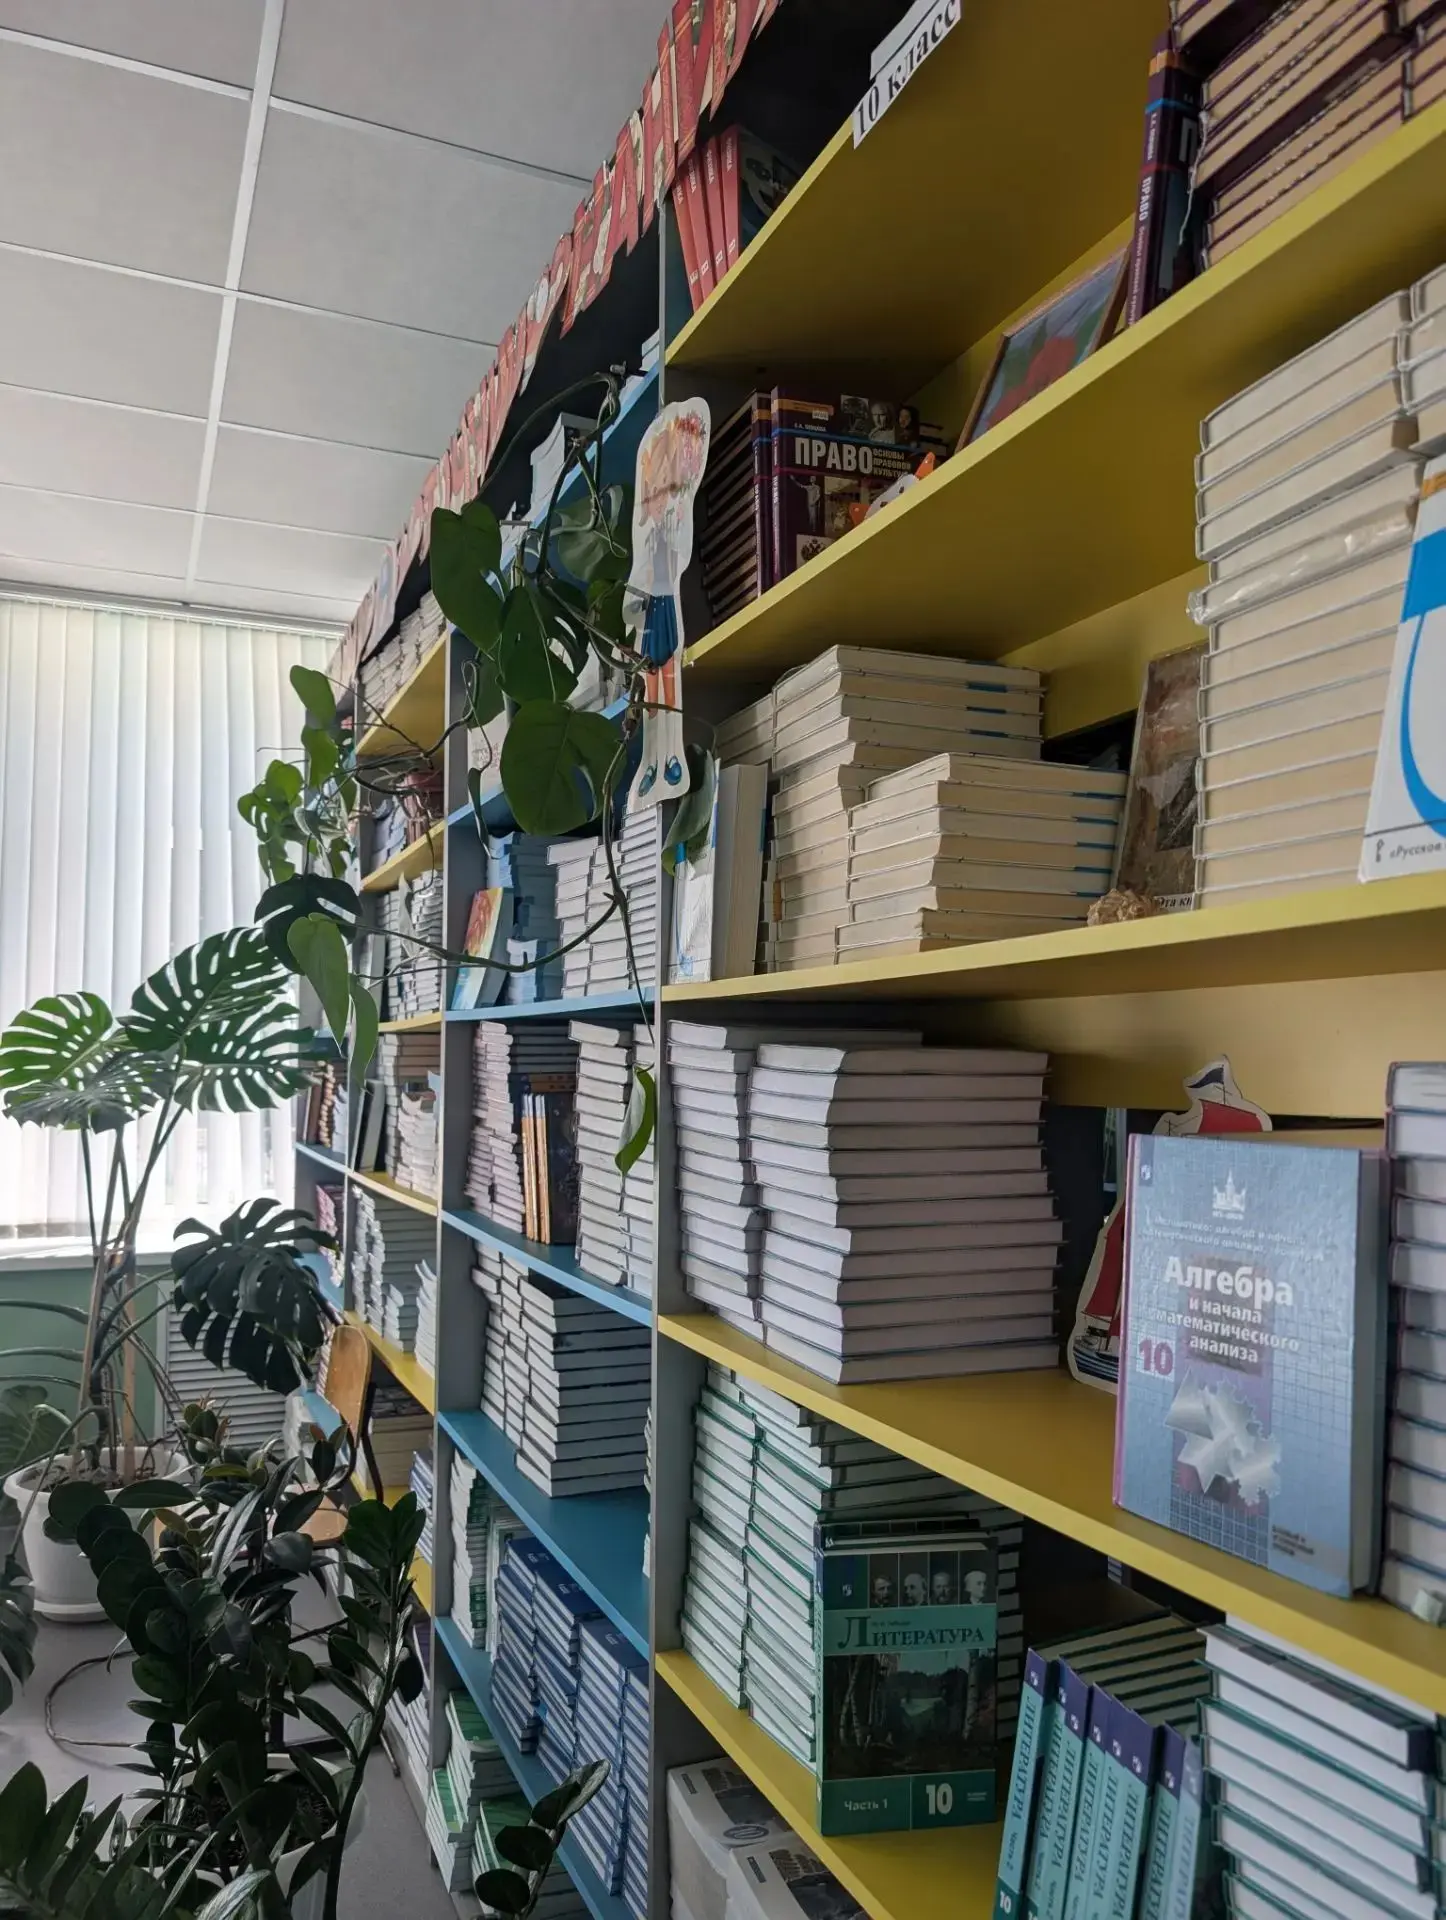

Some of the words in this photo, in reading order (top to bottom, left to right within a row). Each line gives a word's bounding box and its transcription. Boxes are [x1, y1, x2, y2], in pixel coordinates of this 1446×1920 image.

[857, 85, 879, 135] 10
[888, 0, 957, 100] класс
[1139, 176, 1152, 222] ПРАВО
[794, 437, 873, 474] ПРАВО
[1163, 1256, 1293, 1311] Алгебра
[1155, 1310, 1300, 1352] математического
[1189, 1297, 1199, 1310] и
[1202, 1298, 1262, 1324] начала
[1138, 1338, 1174, 1376] 10
[1189, 1334, 1259, 1363] анализа
[838, 1615, 985, 1650] ЛИТЕРАТУРА
[1011, 1699, 1036, 1820] ЛИТЕРАТУРА
[844, 1799, 879, 1812] Часть
[883, 1797, 888, 1809] 1
[925, 1782, 953, 1815] 10
[1051, 1741, 1076, 1869] ЛИТЕРАТУРА
[1074, 1752, 1098, 1882] ЛИТЕРАТУРА
[1093, 1766, 1118, 1900] ЛИТЕРАТУРА
[1113, 1784, 1138, 1919] ЛИТЕРАТУРА
[999, 1889, 1012, 1915] 10
